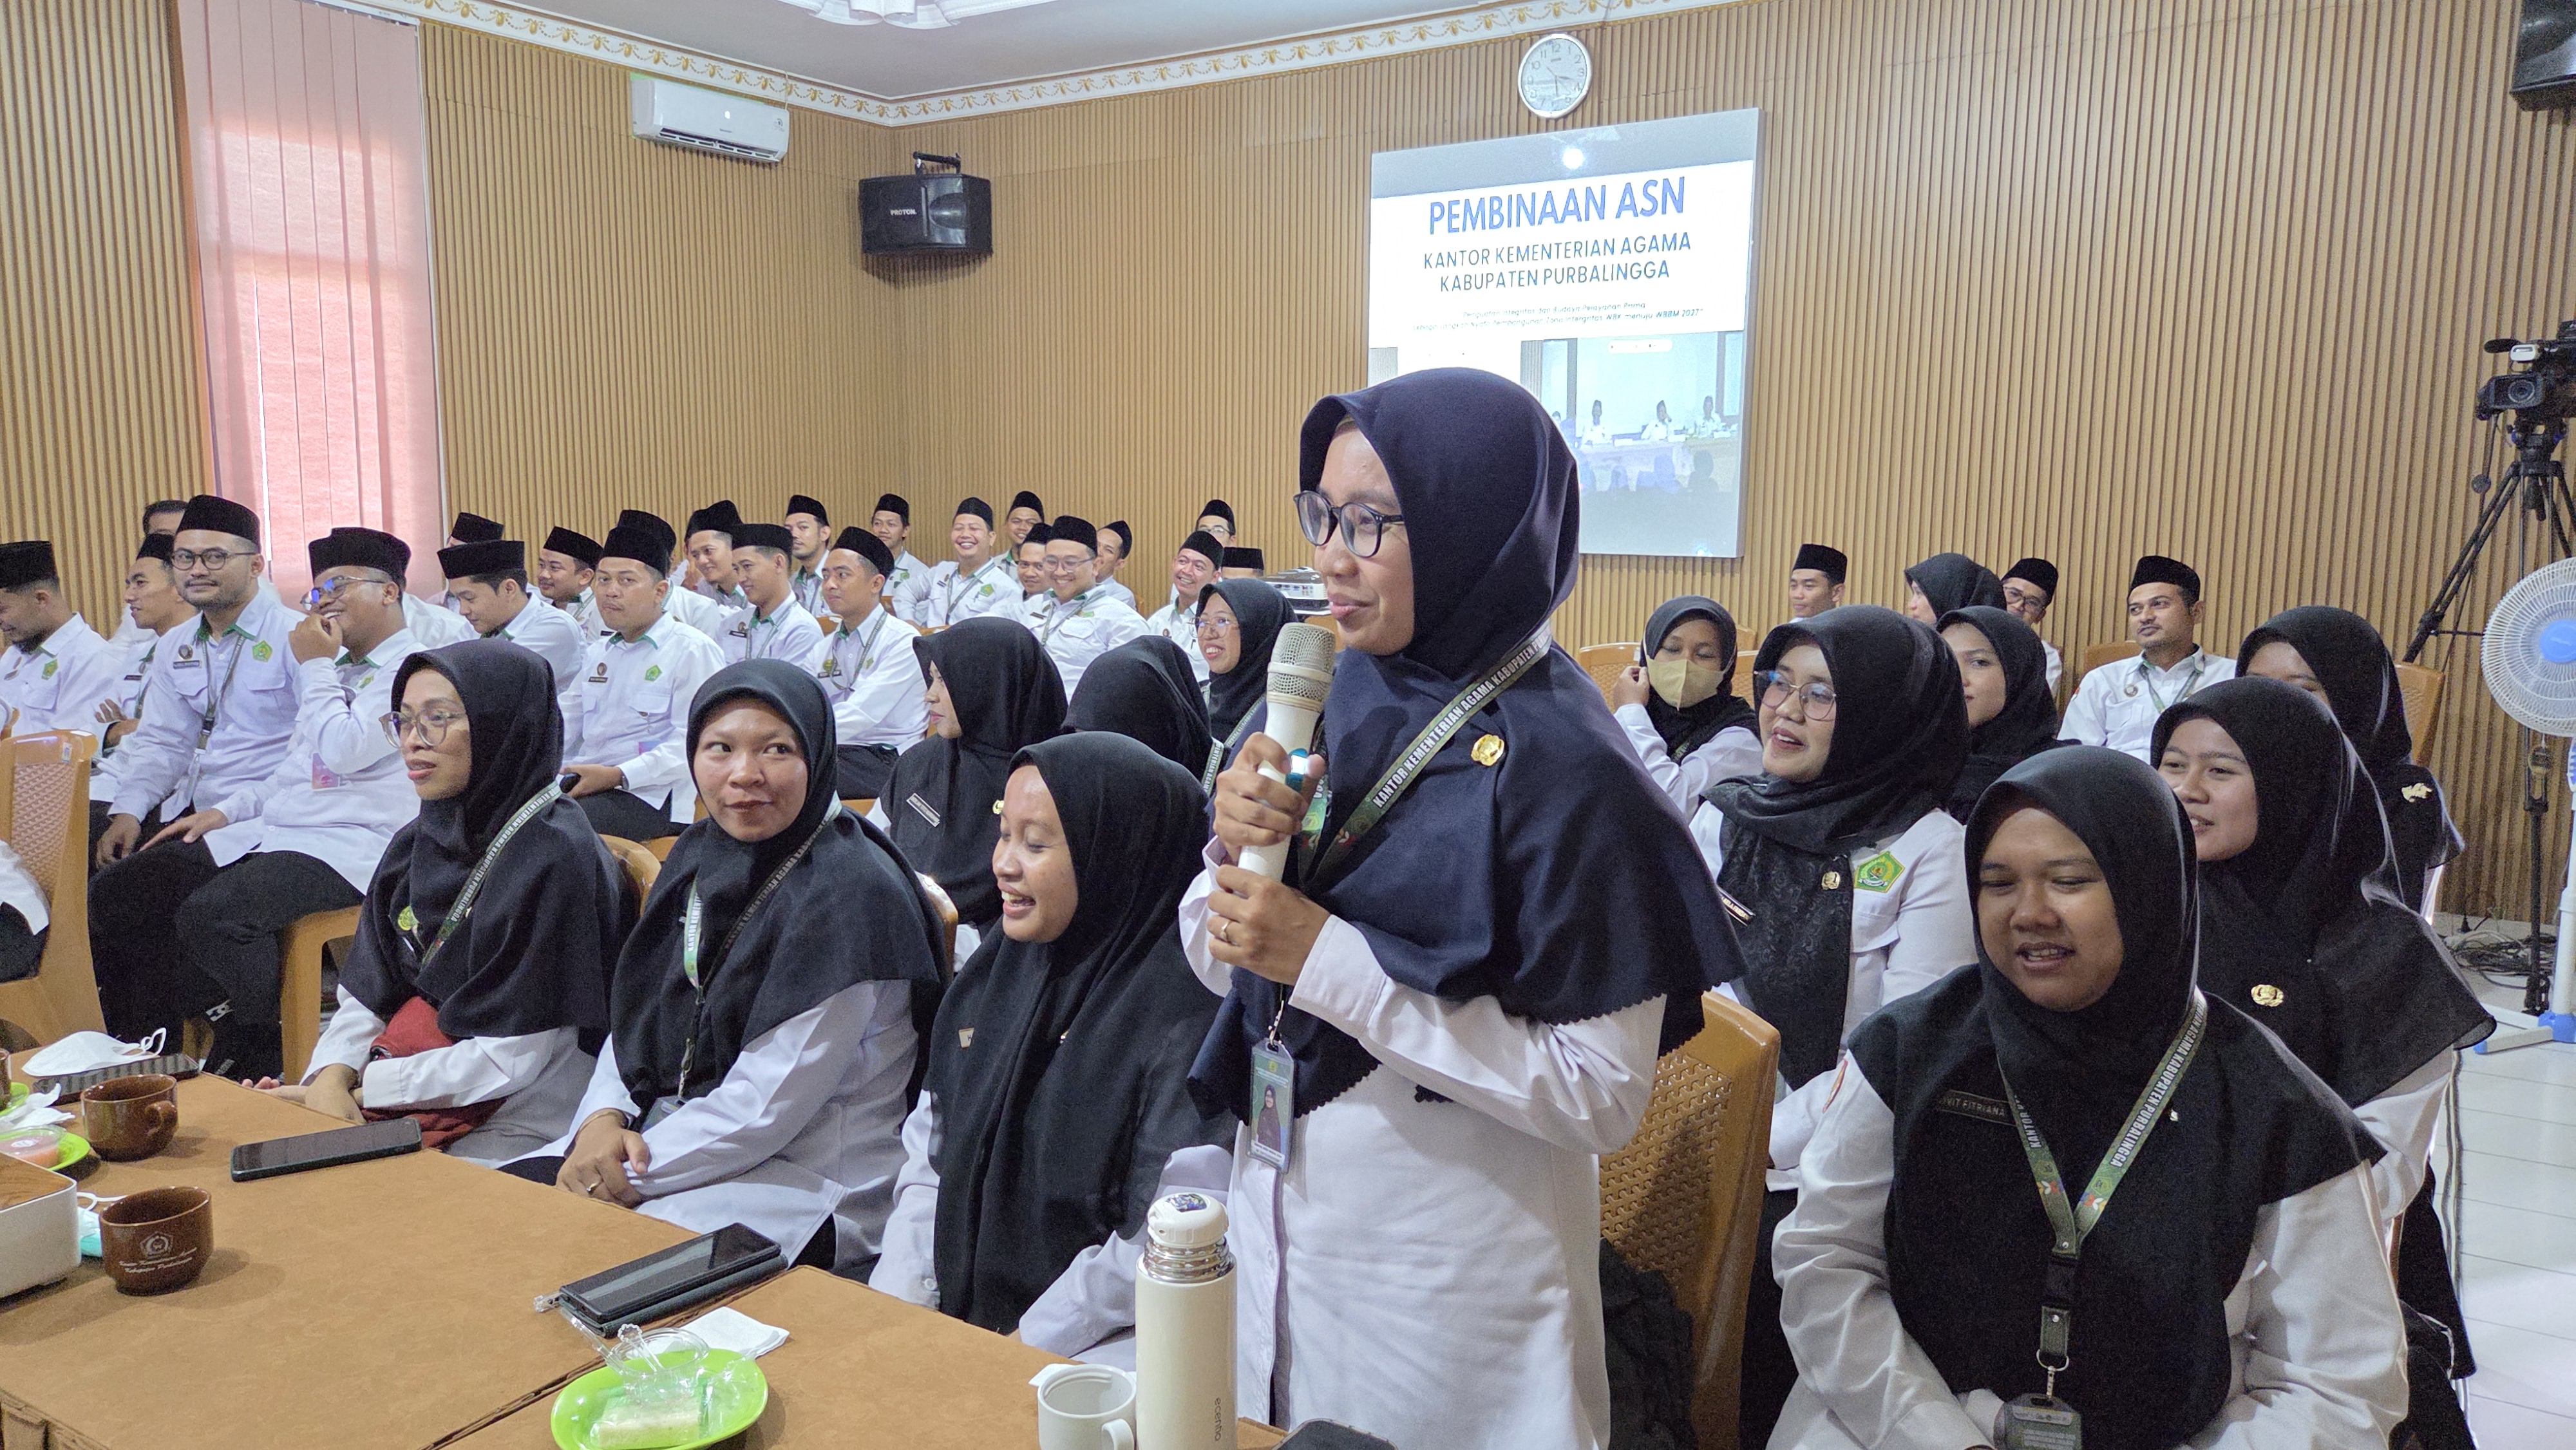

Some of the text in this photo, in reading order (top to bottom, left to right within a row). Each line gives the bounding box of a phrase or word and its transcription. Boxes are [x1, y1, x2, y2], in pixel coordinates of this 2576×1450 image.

[1540, 50, 1547, 59] 11
[1551, 43, 1561, 53] 12
[1575, 54, 1581, 64] 2
[1531, 61, 1540, 70] 10
[1578, 68, 1585, 77] 3
[1430, 176, 1685, 235] PEMBINAAN ASN
[1424, 232, 1691, 269] KANTOR KEMENTERIAN AGAMA
[1440, 260, 1670, 292] KABUPATEN PURBALINGGA
[1656, 310, 1680, 318] WBBM
[1372, 767, 1409, 808] KANTOR
[1403, 706, 1464, 771] KEMENTERIAN
[1460, 680, 1495, 711] AGAMA
[1491, 646, 1535, 686] KABUPATEN
[511, 791, 554, 829] KEMENTERIAN
[495, 825, 515, 848] AGAMA
[473, 845, 498, 884] KABUPATEN
[775, 857, 798, 881] AGAMA
[450, 878, 478, 923] PURBALINGGA
[687, 924, 697, 952] KANTOR
[2178, 1026, 2199, 1057] AGAMA
[2147, 1052, 2186, 1107] KABUPATEN
[2020, 1111, 2042, 1149] KANTOR
[2110, 1103, 2156, 1168] PURBALINGGA
